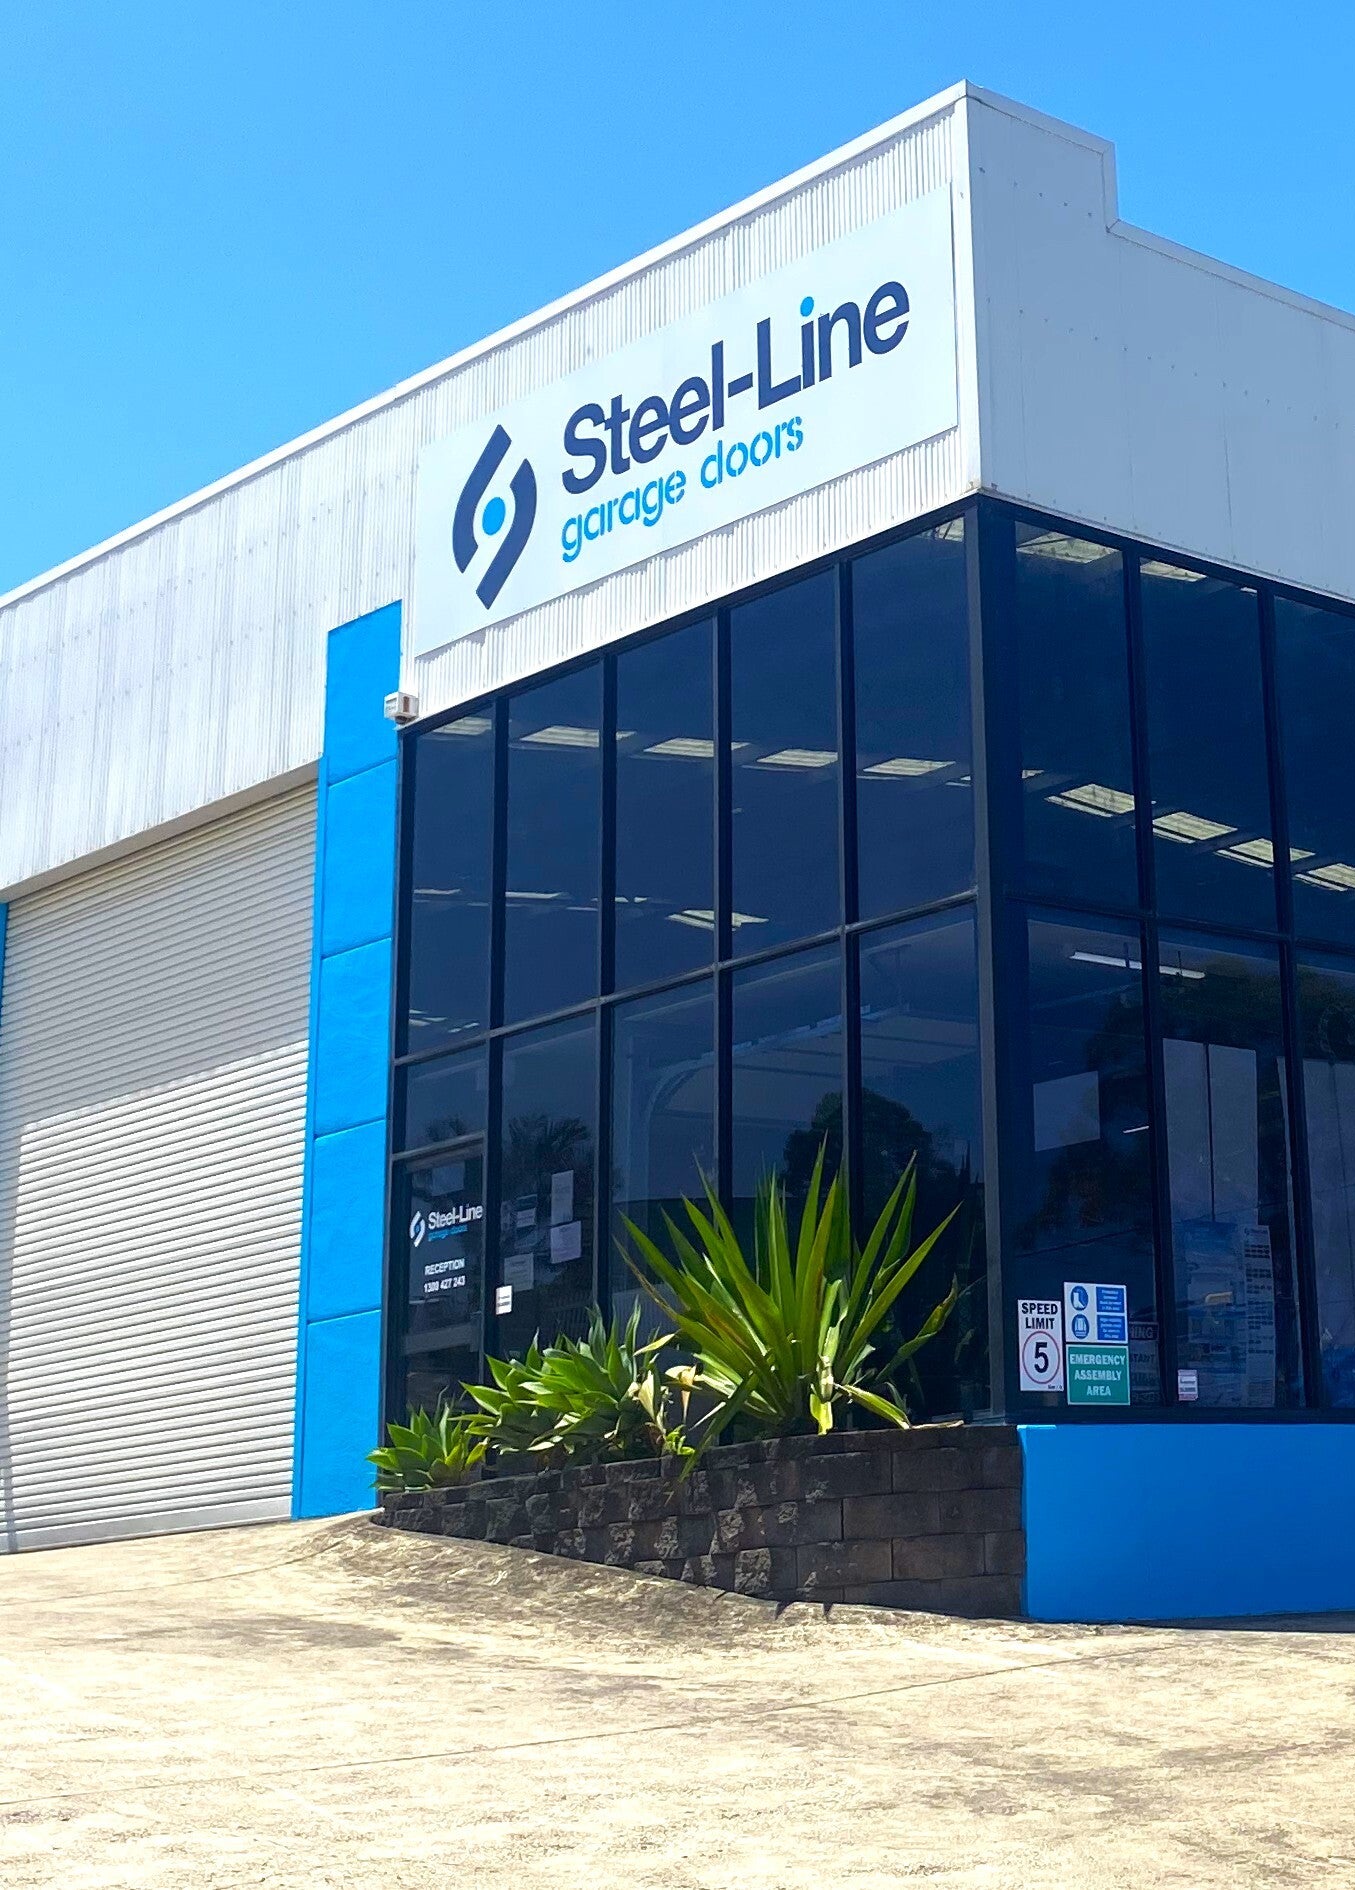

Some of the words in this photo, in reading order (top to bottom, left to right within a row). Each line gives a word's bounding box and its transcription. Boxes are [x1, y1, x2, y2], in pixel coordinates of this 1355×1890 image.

[561, 281, 910, 494] Steel-Line
[562, 469, 686, 563] garage
[700, 416, 804, 489] doors
[428, 1203, 483, 1230] Steel-Line
[424, 1258, 466, 1276] RECEPTION
[1021, 1302, 1058, 1315] SPEED
[1025, 1317, 1055, 1330] LIMIT
[1034, 1341, 1049, 1374] 5
[1069, 1353, 1126, 1366] EMERGENCY
[1074, 1369, 1122, 1381] ASSEMBLY
[1086, 1385, 1112, 1396] AREA
